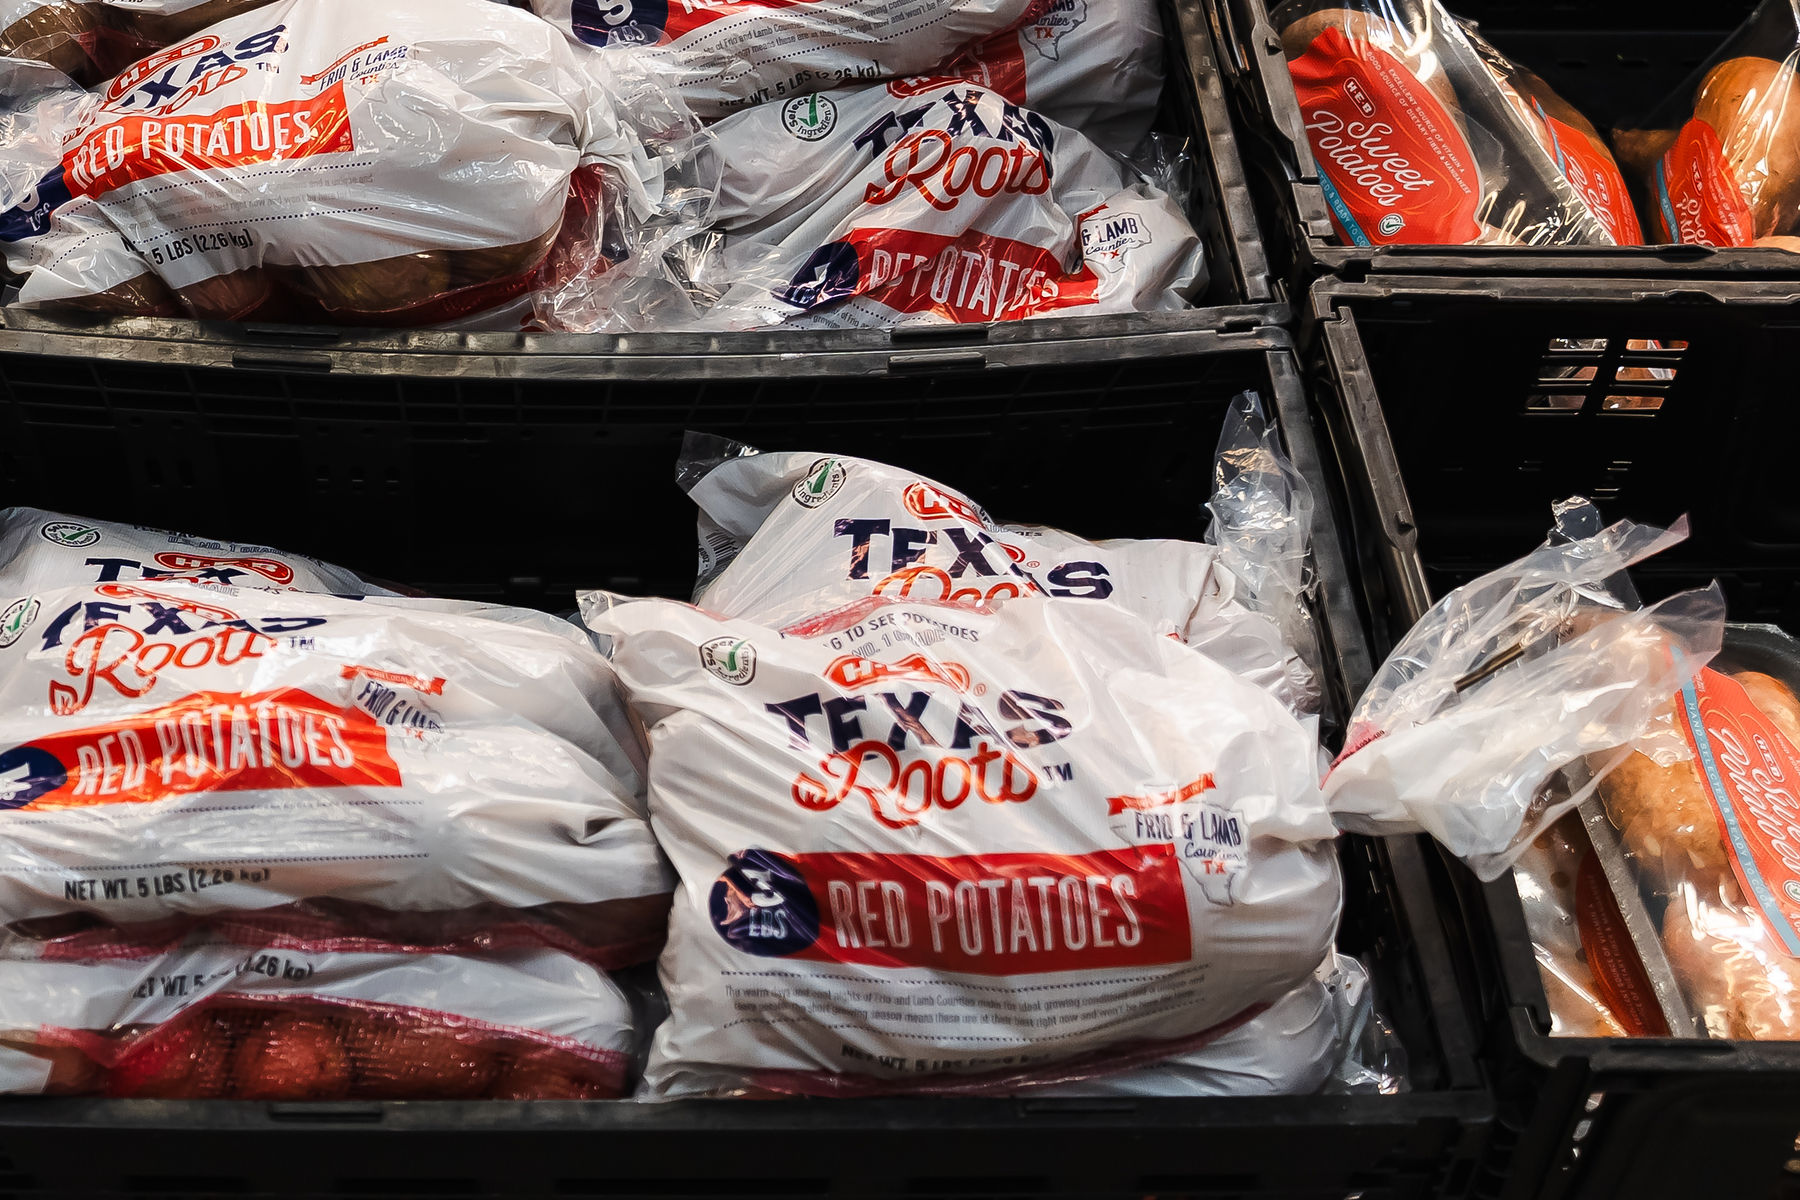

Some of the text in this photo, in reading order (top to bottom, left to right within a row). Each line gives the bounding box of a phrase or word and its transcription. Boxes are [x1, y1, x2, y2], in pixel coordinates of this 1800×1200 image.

[319, 45, 410, 93] FRIO LAMB
[777, 60, 882, 94] 5 kg)
[1380, 71, 1400, 97] SOURCE
[1406, 109, 1429, 137] DIETARY
[1427, 137, 1442, 155] FIBER
[1388, 69, 1461, 169] EXCELLENT SOURCE VITAMIN
[71, 109, 313, 191] RED POTATOES
[864, 128, 1053, 212] Roots
[1306, 111, 1403, 207] Potatoes
[1348, 121, 1434, 191] Sweet
[1097, 216, 1140, 249] LAMB
[1334, 198, 1350, 222] READY
[150, 228, 254, 266] 5 LBS (2.26 kg)
[1085, 236, 1136, 258] Counties
[48, 623, 275, 717] Roots
[74, 699, 355, 797] RED POTATOES
[764, 689, 1074, 753] TEXAS
[790, 741, 1039, 830] Roots
[1134, 809, 1242, 847] FRIO LAMB
[64, 873, 186, 901] NET WT. 5 LBS
[1203, 860, 1227, 875] TX
[747, 907, 788, 940] LBS
[827, 875, 1144, 956] RED POTATOES
